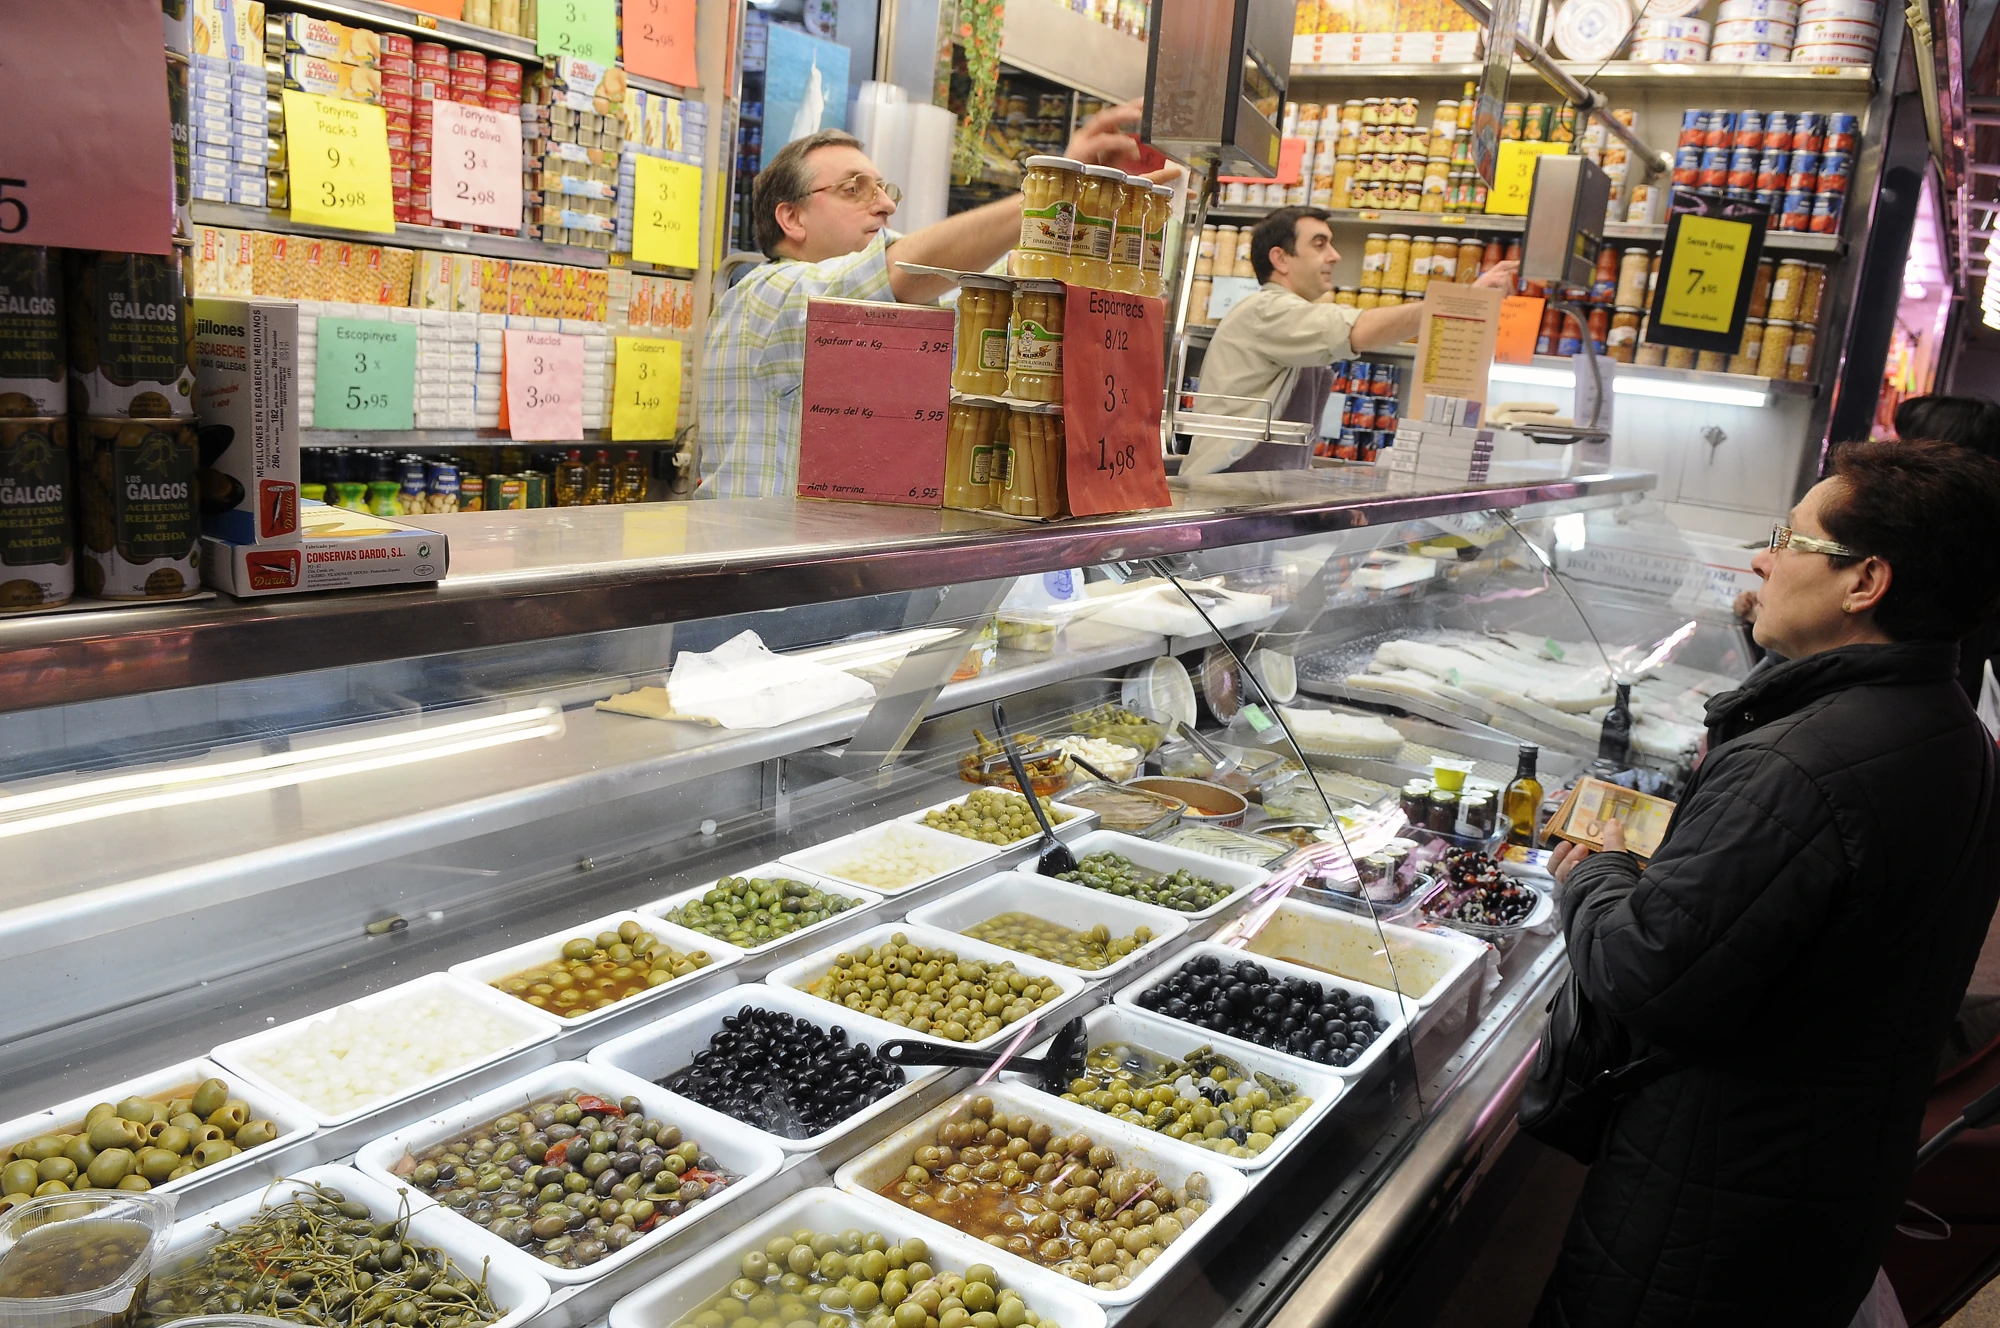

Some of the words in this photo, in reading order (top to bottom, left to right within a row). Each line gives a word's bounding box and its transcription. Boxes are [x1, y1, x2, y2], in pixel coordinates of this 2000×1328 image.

[566, 3, 576, 23] 3
[559, 32, 593, 58] 2,98
[643, 24, 675, 48] 2,98
[314, 101, 359, 121] Tonyina
[318, 121, 358, 138] Pack-3
[452, 124, 467, 136] Oli
[327, 147, 341, 169] 9
[463, 149, 476, 170] 3
[321, 181, 366, 209] 3,98
[456, 180, 496, 206] 2,98
[660, 182, 668, 201] 3
[653, 210, 681, 233] 2,00
[108, 292, 125, 302] LOS
[1089, 291, 1144, 320] Espàrrecs
[109, 302, 177, 322] GALGOS
[109, 322, 177, 333] ACEITUNAS
[253, 309, 262, 356] MEDIANOS
[336, 326, 397, 345] Escopinyes
[108, 333, 179, 345] RELLENAS
[814, 336, 852, 347] Agafant
[870, 339, 883, 351] Kg
[919, 341, 949, 354] 3,95
[1104, 329, 1129, 351] 8/12
[2, 351, 56, 361] ANCHOA
[116, 354, 175, 364] ANCHOA
[354, 352, 367, 374] 3
[533, 356, 544, 375] 3
[216, 360, 247, 372] GALLEGAS
[639, 362, 648, 380] 3
[254, 358, 263, 409] ESCABECHE
[346, 386, 388, 411] 5,95
[526, 386, 561, 408] 3,00
[633, 391, 660, 410] 1,49
[1104, 375, 1115, 412] 3
[1121, 388, 1129, 404] x
[255, 411, 263, 424] EN
[271, 409, 280, 424] 182
[809, 404, 840, 415] Menys
[844, 406, 859, 416] del
[861, 408, 873, 419] Kg
[914, 409, 944, 422] 5,95
[255, 425, 264, 478] MEJILLONES
[272, 453, 280, 469] 260
[1096, 436, 1136, 480] 1,98
[125, 475, 141, 484] LOS
[1, 484, 62, 504] GALGOS
[126, 482, 188, 500] GALGOS
[832, 484, 865, 494] tarrina
[908, 487, 938, 500] 6,95
[1, 505, 63, 516] ACEITUNAS
[126, 501, 189, 512] ACEITUNAS
[284, 493, 294, 530] Dardo
[0, 515, 65, 528] RELLENAS
[124, 511, 191, 523] RELLENAS
[8, 536, 62, 549] ANCHOA
[133, 531, 187, 542] ANCHOA
[306, 550, 356, 564] CONSERVAS
[359, 548, 390, 561] DARDO,
[391, 547, 406, 558] S.L.
[254, 574, 289, 587] Dardo
